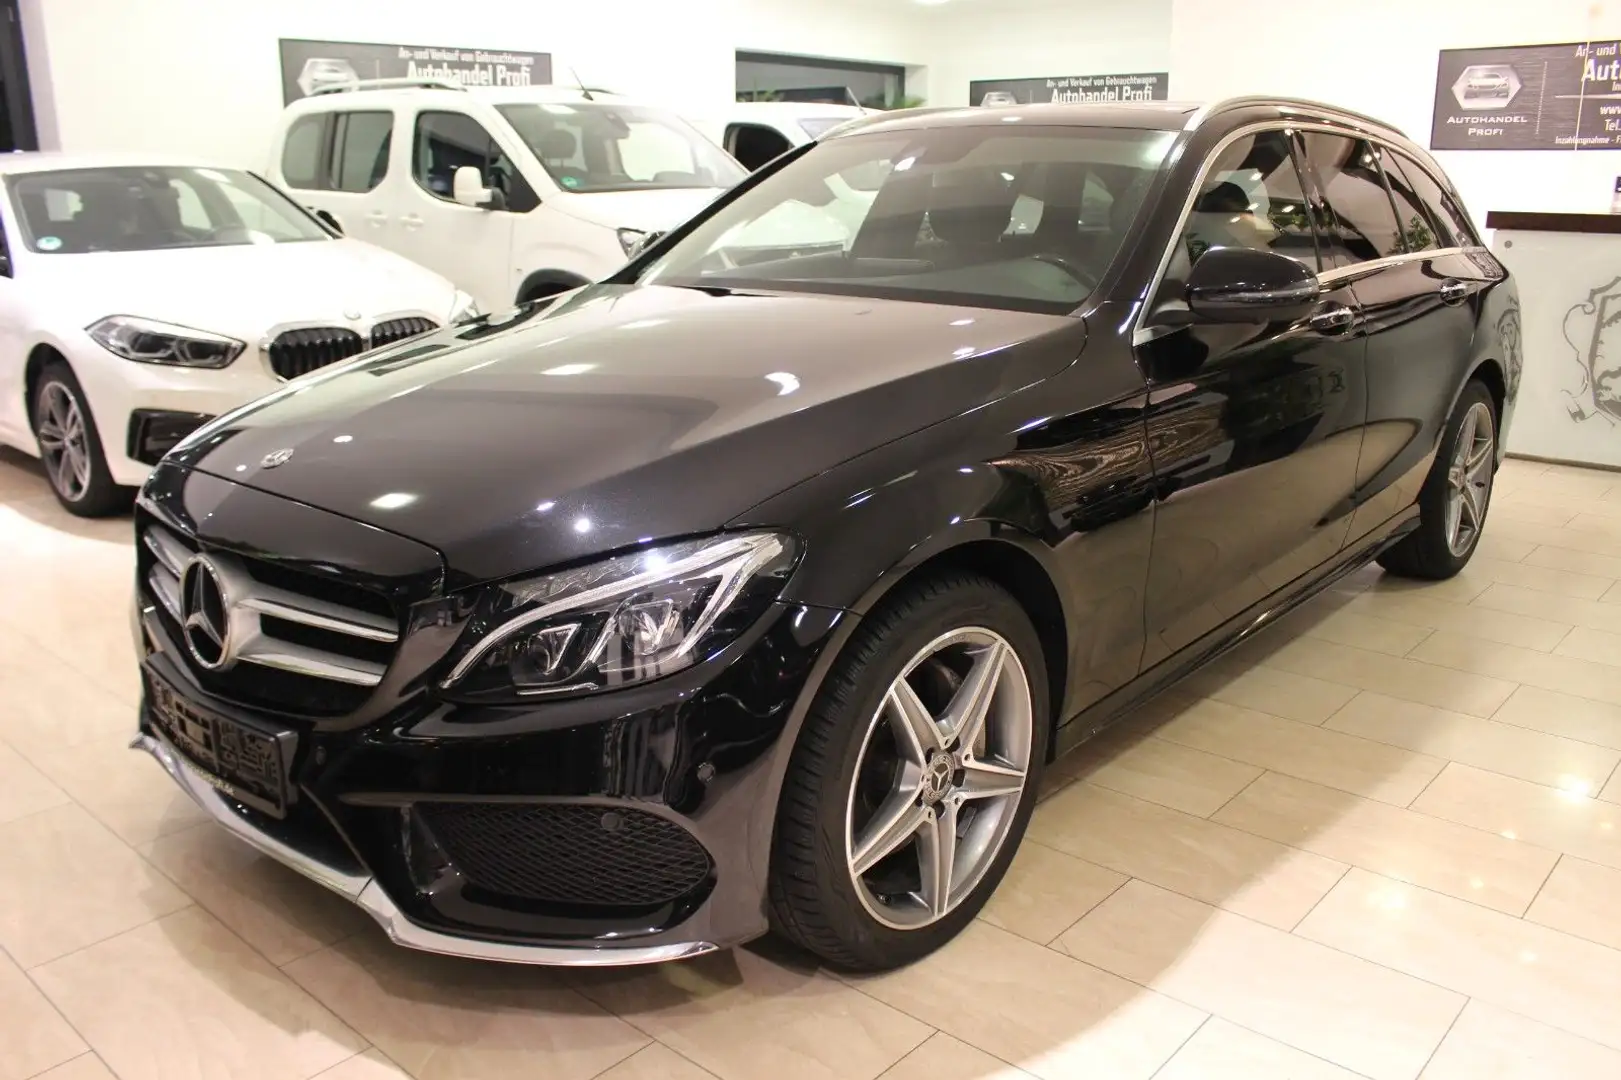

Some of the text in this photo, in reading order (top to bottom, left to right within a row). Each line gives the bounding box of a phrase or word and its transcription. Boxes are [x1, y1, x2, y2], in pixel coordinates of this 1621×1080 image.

[430, 48, 460, 62] Verkauf
[460, 52, 475, 62] von
[1596, 43, 1618, 56] und
[407, 60, 532, 87] Autohandel Profi
[1581, 58, 1621, 82] Aut
[1058, 79, 1069, 88] und
[1070, 77, 1093, 87] Verkauf
[1094, 78, 1105, 86] von
[1106, 75, 1157, 86] Gebrauchtwagen
[1051, 85, 1152, 104] Autohandel Profi
[1446, 116, 1528, 124] AUTOHANDEL
[1468, 128, 1503, 136] PROFI
